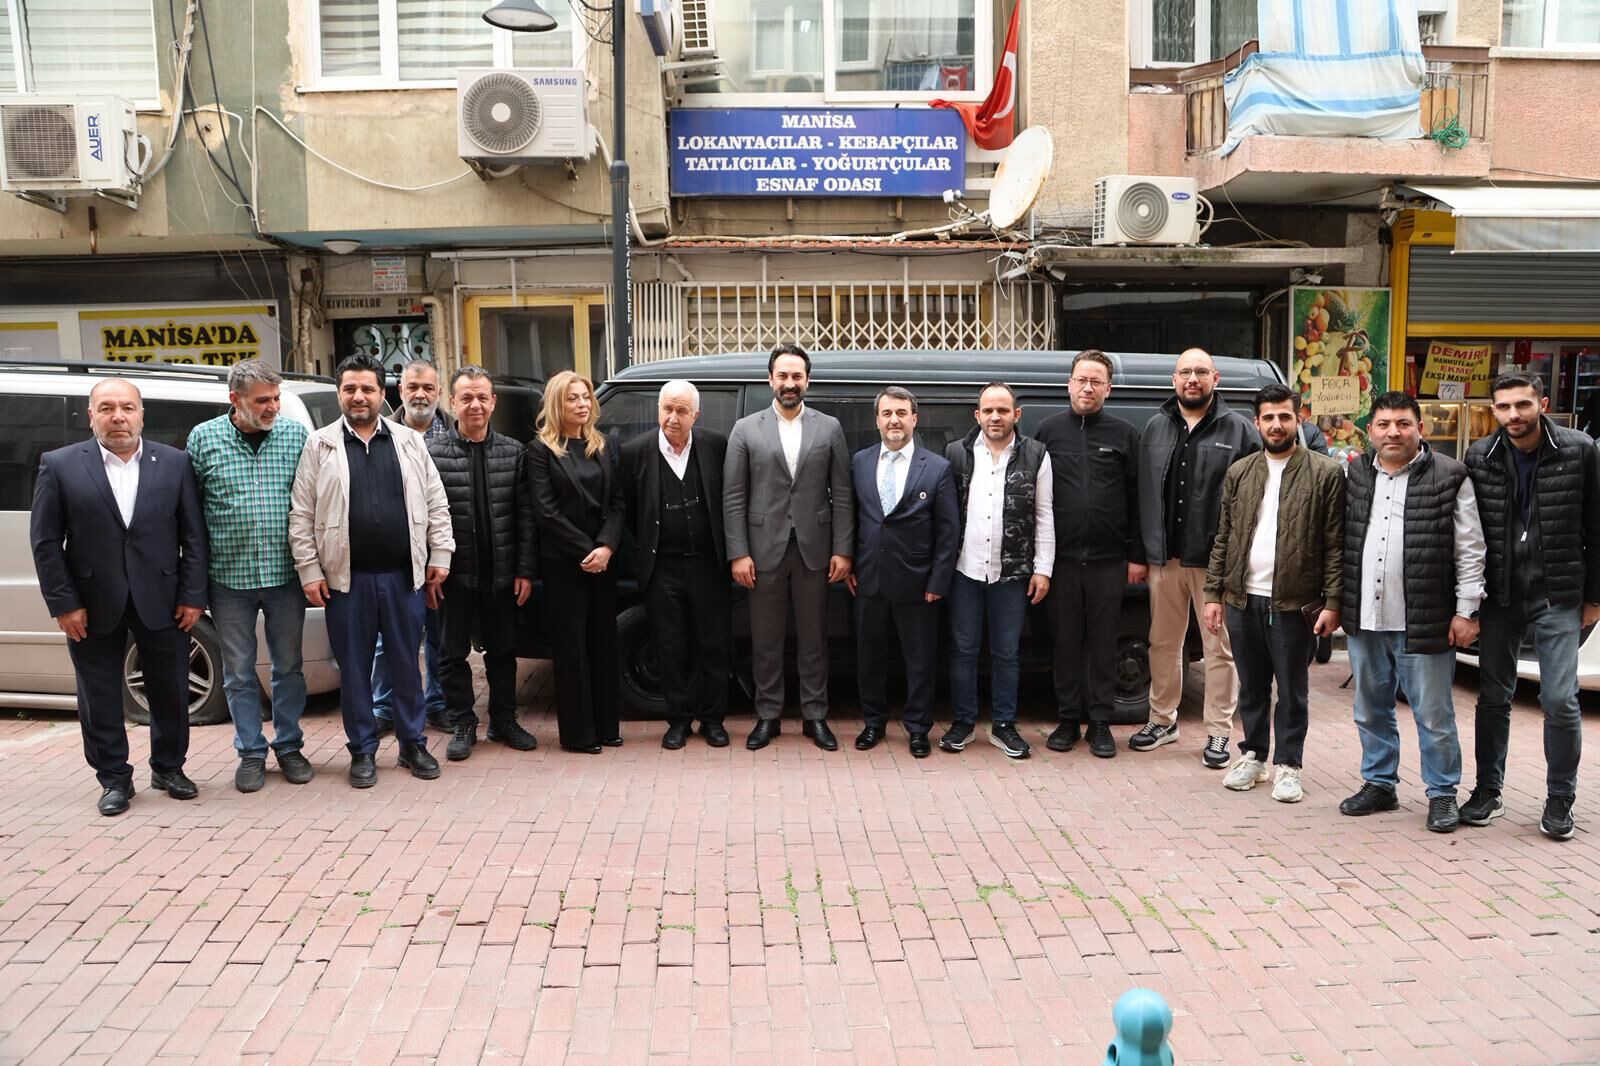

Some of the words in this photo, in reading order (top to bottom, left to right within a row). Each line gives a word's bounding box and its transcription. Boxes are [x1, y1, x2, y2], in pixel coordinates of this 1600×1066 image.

[533, 77, 577, 86] SAMSUNG
[781, 111, 857, 129] MANİSA
[88, 115, 103, 162] AUER
[677, 135, 823, 150] LOKANTACILAR
[838, 135, 959, 154] KEBAPÇILAR
[685, 157, 797, 171] TATLICILAR
[811, 152, 952, 175] YOĞURTÇULAR
[755, 177, 819, 192] ESNAF
[823, 177, 882, 192] ODASI
[103, 323, 257, 349] MANİSA'DA
